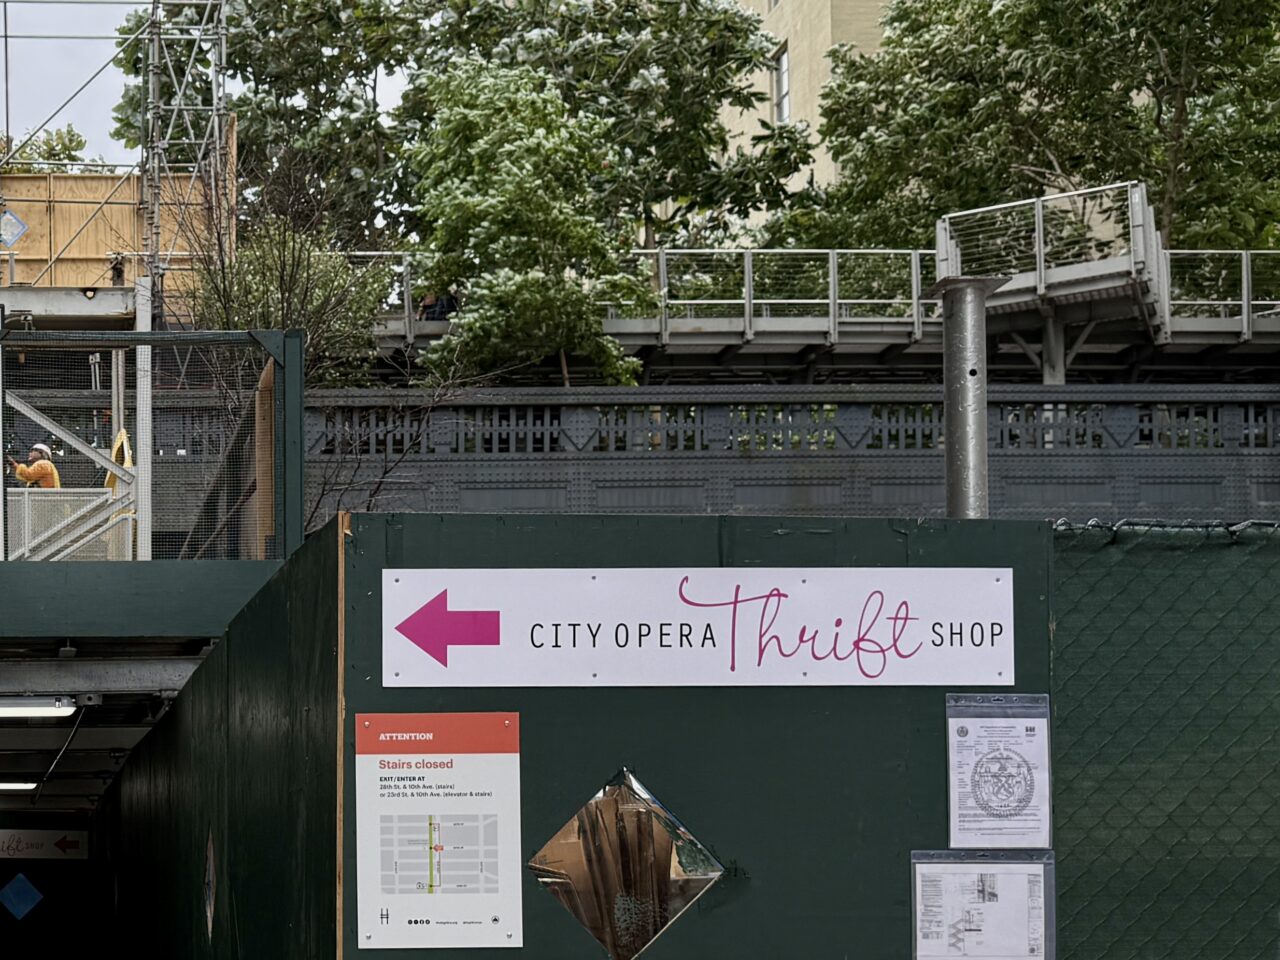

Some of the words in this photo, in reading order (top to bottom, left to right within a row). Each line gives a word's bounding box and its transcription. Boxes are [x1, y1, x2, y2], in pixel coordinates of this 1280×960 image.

[530, 622, 601, 648] CITY
[615, 622, 716, 648] OPERA
[678, 575, 923, 679] Thrift
[931, 621, 1004, 647] SHOP
[379, 732, 433, 741] ATTENTION
[379, 759, 412, 770] Stairs
[415, 758, 454, 770] closed
